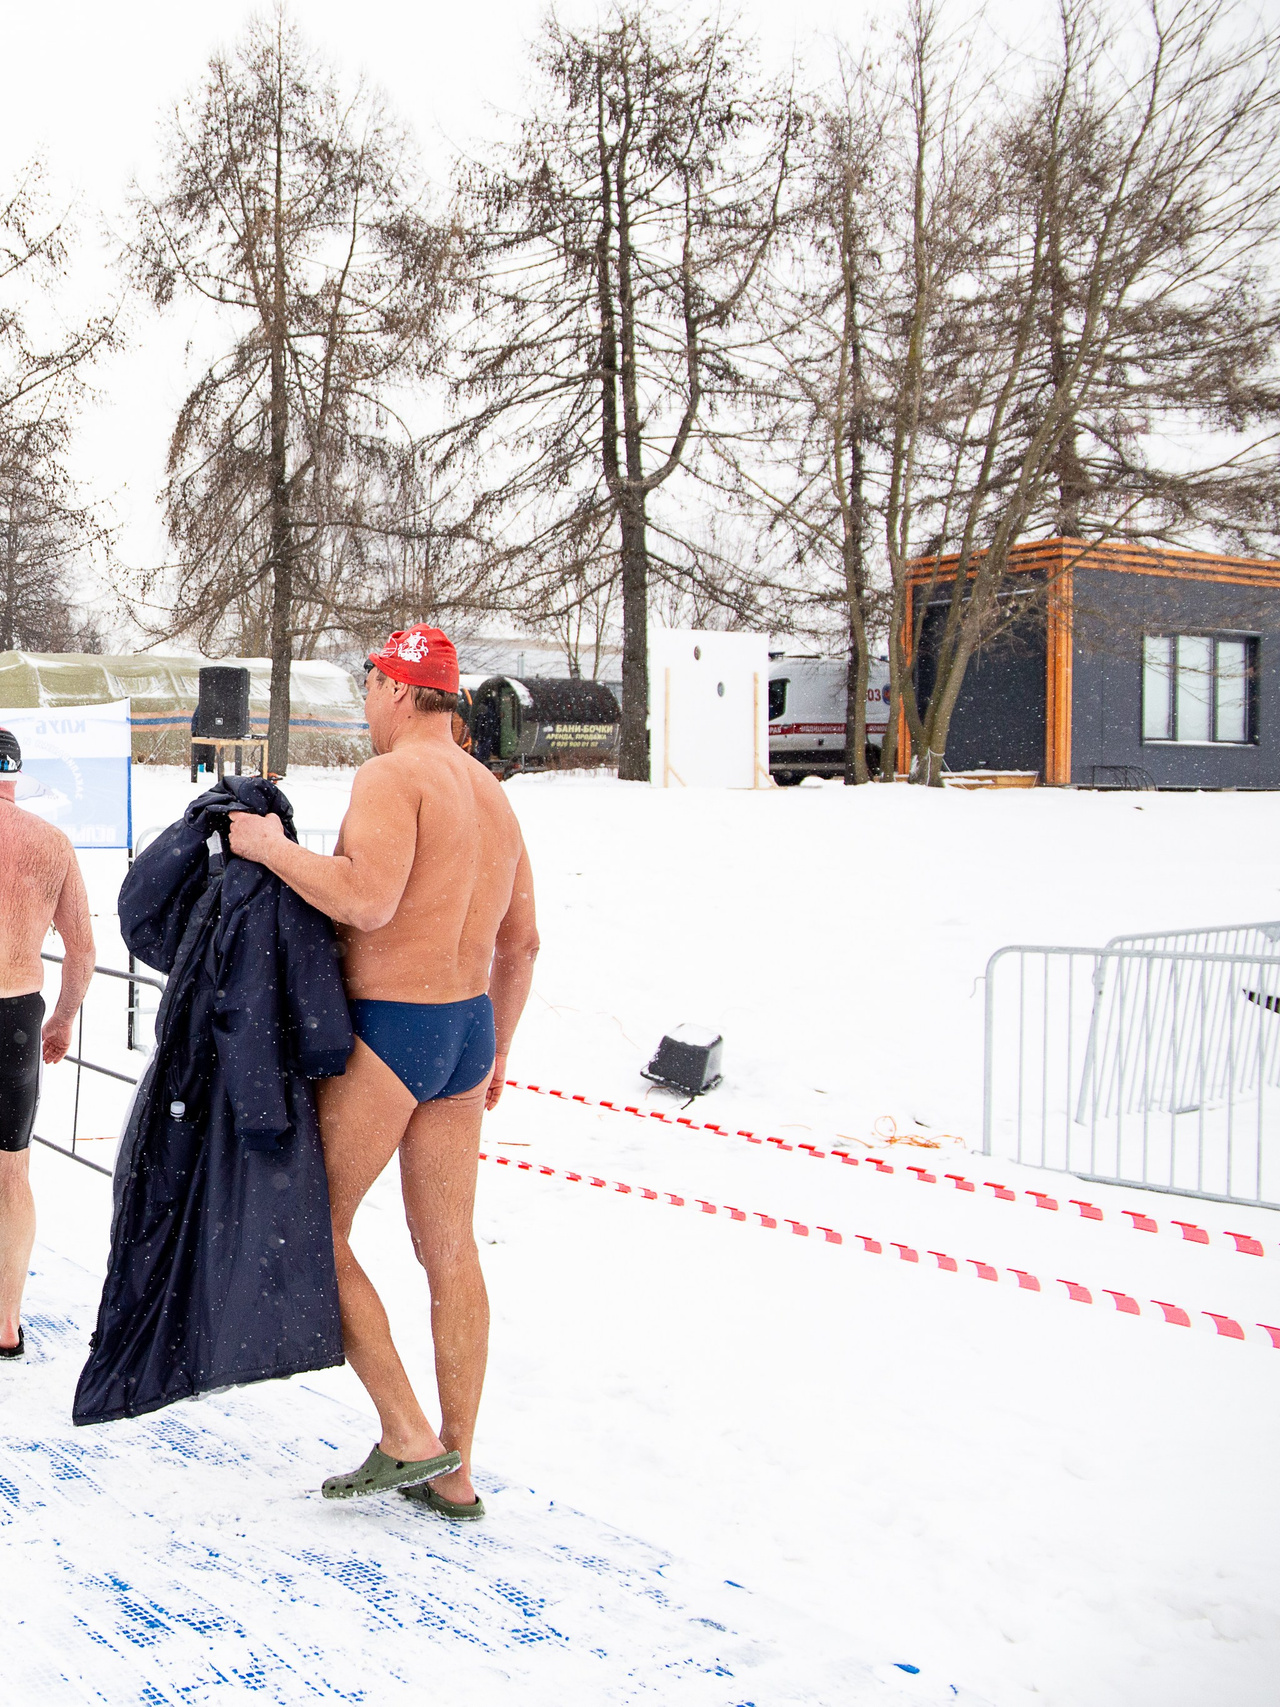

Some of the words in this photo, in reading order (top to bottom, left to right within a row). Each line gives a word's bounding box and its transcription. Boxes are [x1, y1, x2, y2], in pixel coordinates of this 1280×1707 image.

[867, 688, 881, 702] 03
[555, 724, 613, 733] БАНИ-БОЧКИ
[769, 726, 782, 734] РАЯ
